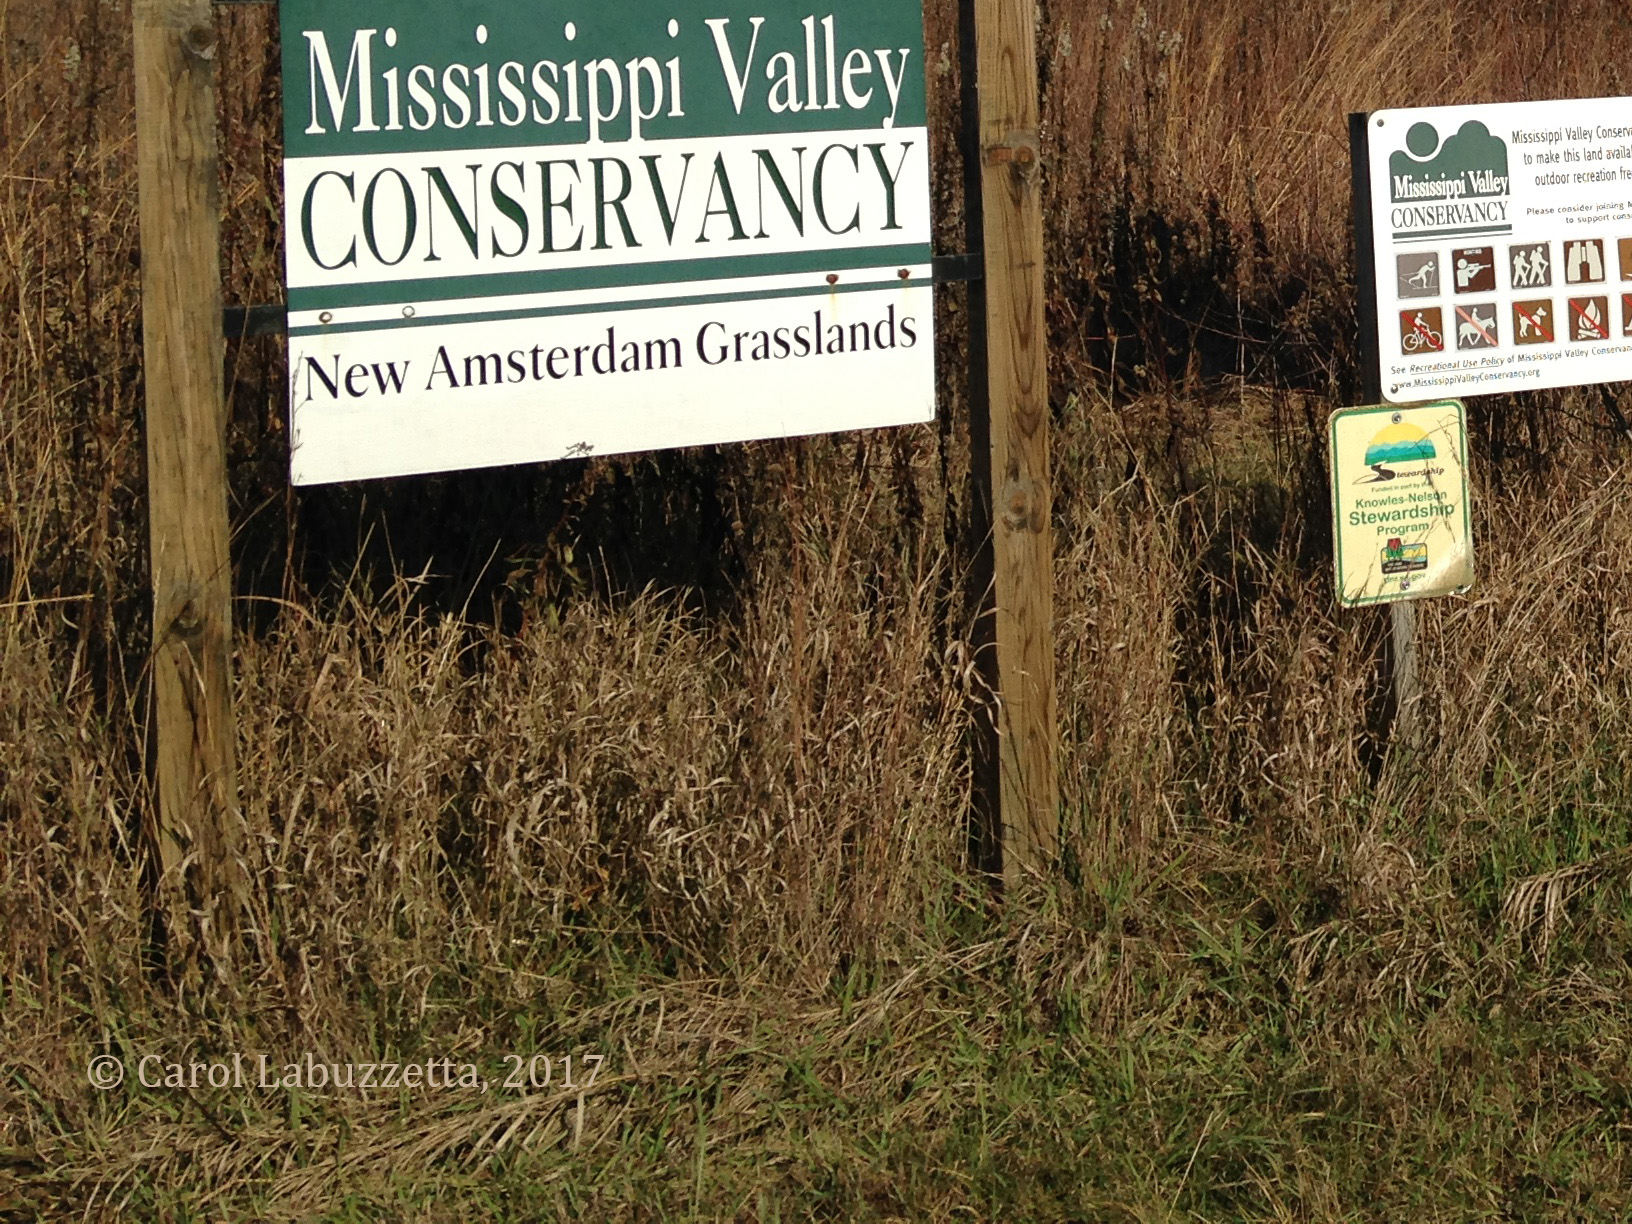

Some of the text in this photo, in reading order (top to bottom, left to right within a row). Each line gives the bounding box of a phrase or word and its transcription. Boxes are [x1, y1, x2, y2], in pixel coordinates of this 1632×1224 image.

[302, 14, 910, 144] Mississippi Valley
[1512, 126, 1562, 145] Mississippi
[1565, 126, 1593, 143] Valley
[1523, 152, 1533, 165] to
[1536, 150, 1560, 164] make
[1563, 148, 1580, 163] this
[1583, 147, 1603, 161] land
[1393, 169, 1508, 200] Mississippi Valley
[1535, 172, 1570, 186] outdoor
[1573, 167, 1617, 183] recreation
[301, 141, 914, 270] CONSERVANCY
[1391, 201, 1508, 228] CONSERVANCY
[1526, 207, 1555, 215] Please
[1557, 203, 1593, 214] consider
[1596, 202, 1624, 212] joining
[1577, 214, 1610, 224] support
[305, 303, 917, 402] New Amsterdam Grasslands
[1391, 366, 1407, 375] See
[1410, 360, 1460, 373] Recreational
[1462, 360, 1478, 368] Use
[1480, 357, 1505, 368] Policy
[1507, 355, 1515, 363] of
[1517, 350, 1562, 362] Mississippi
[1565, 348, 1589, 358] Valley
[1371, 485, 1393, 493] Funded
[1355, 491, 1447, 509] Knowles-Nelson
[1349, 503, 1455, 526] Stewardship
[1377, 522, 1429, 536] Program
